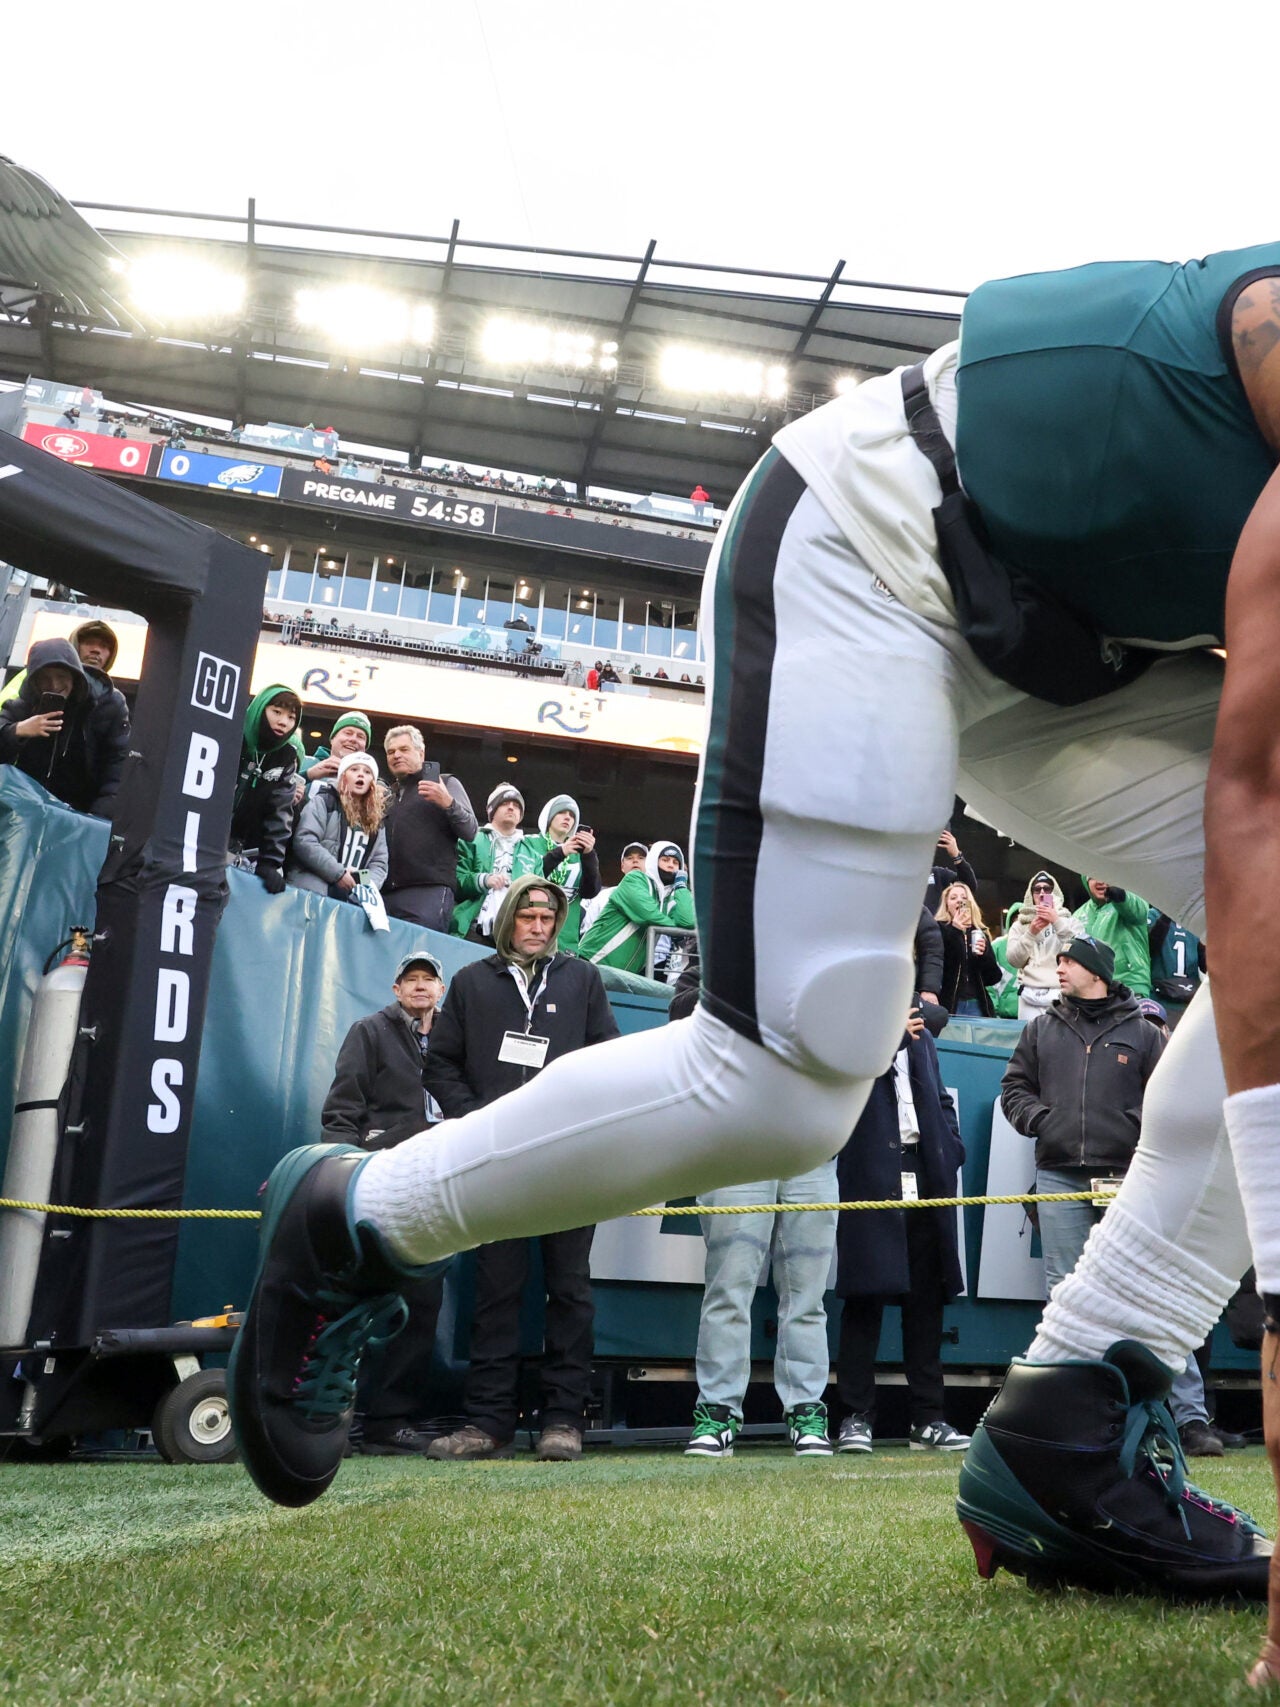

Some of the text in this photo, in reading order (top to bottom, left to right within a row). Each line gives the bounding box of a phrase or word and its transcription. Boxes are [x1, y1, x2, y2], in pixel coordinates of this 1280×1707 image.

[119, 446, 140, 467] 0
[170, 455, 190, 476] 0
[303, 481, 485, 527] PREGAME 54:58
[195, 656, 237, 715] GO
[146, 731, 221, 1135] BIRDS
[1173, 940, 1187, 978] 1
